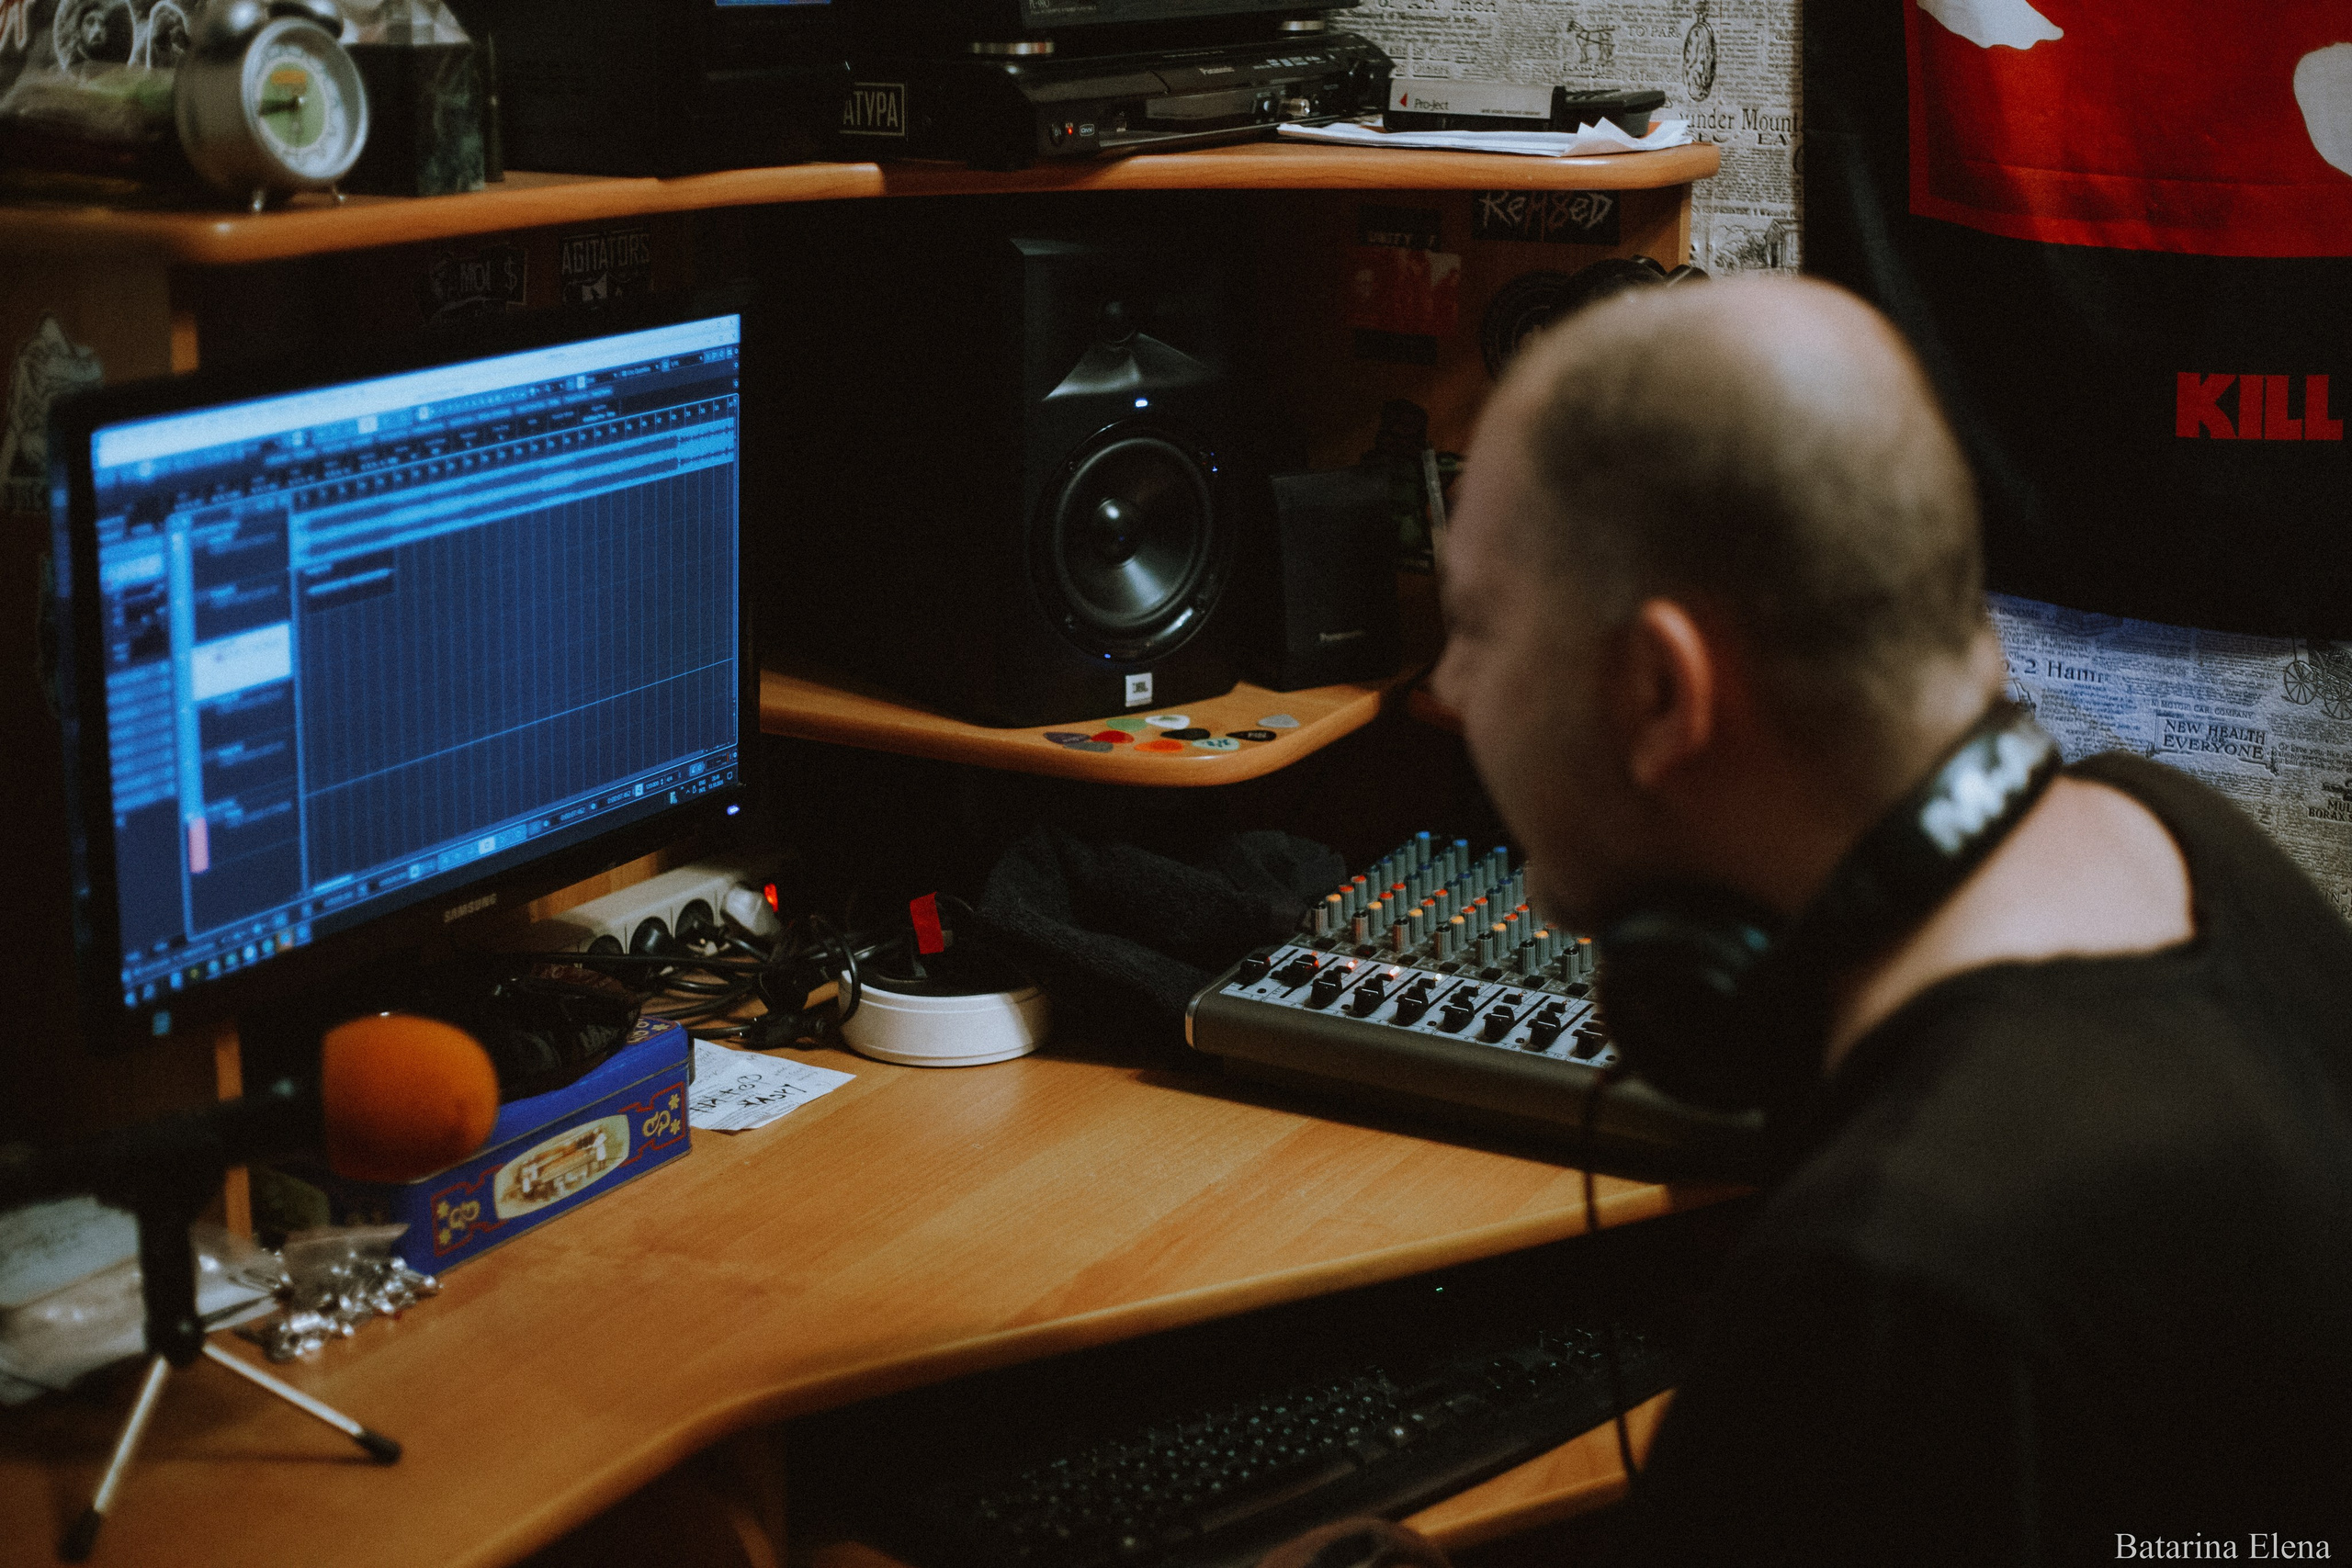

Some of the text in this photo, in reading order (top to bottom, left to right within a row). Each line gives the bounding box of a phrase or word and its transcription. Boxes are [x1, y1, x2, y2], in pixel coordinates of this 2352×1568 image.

[2176, 372, 2343, 441] KILL
[2024, 659, 2037, 675] 2
[2193, 704, 2211, 715] CAR
[2214, 707, 2254, 720] COMPANY
[2164, 718, 2204, 734] NEW
[2208, 724, 2267, 746] HEALTH
[2164, 735, 2265, 760] EVERYONE
[2308, 807, 2346, 822] BORAX
